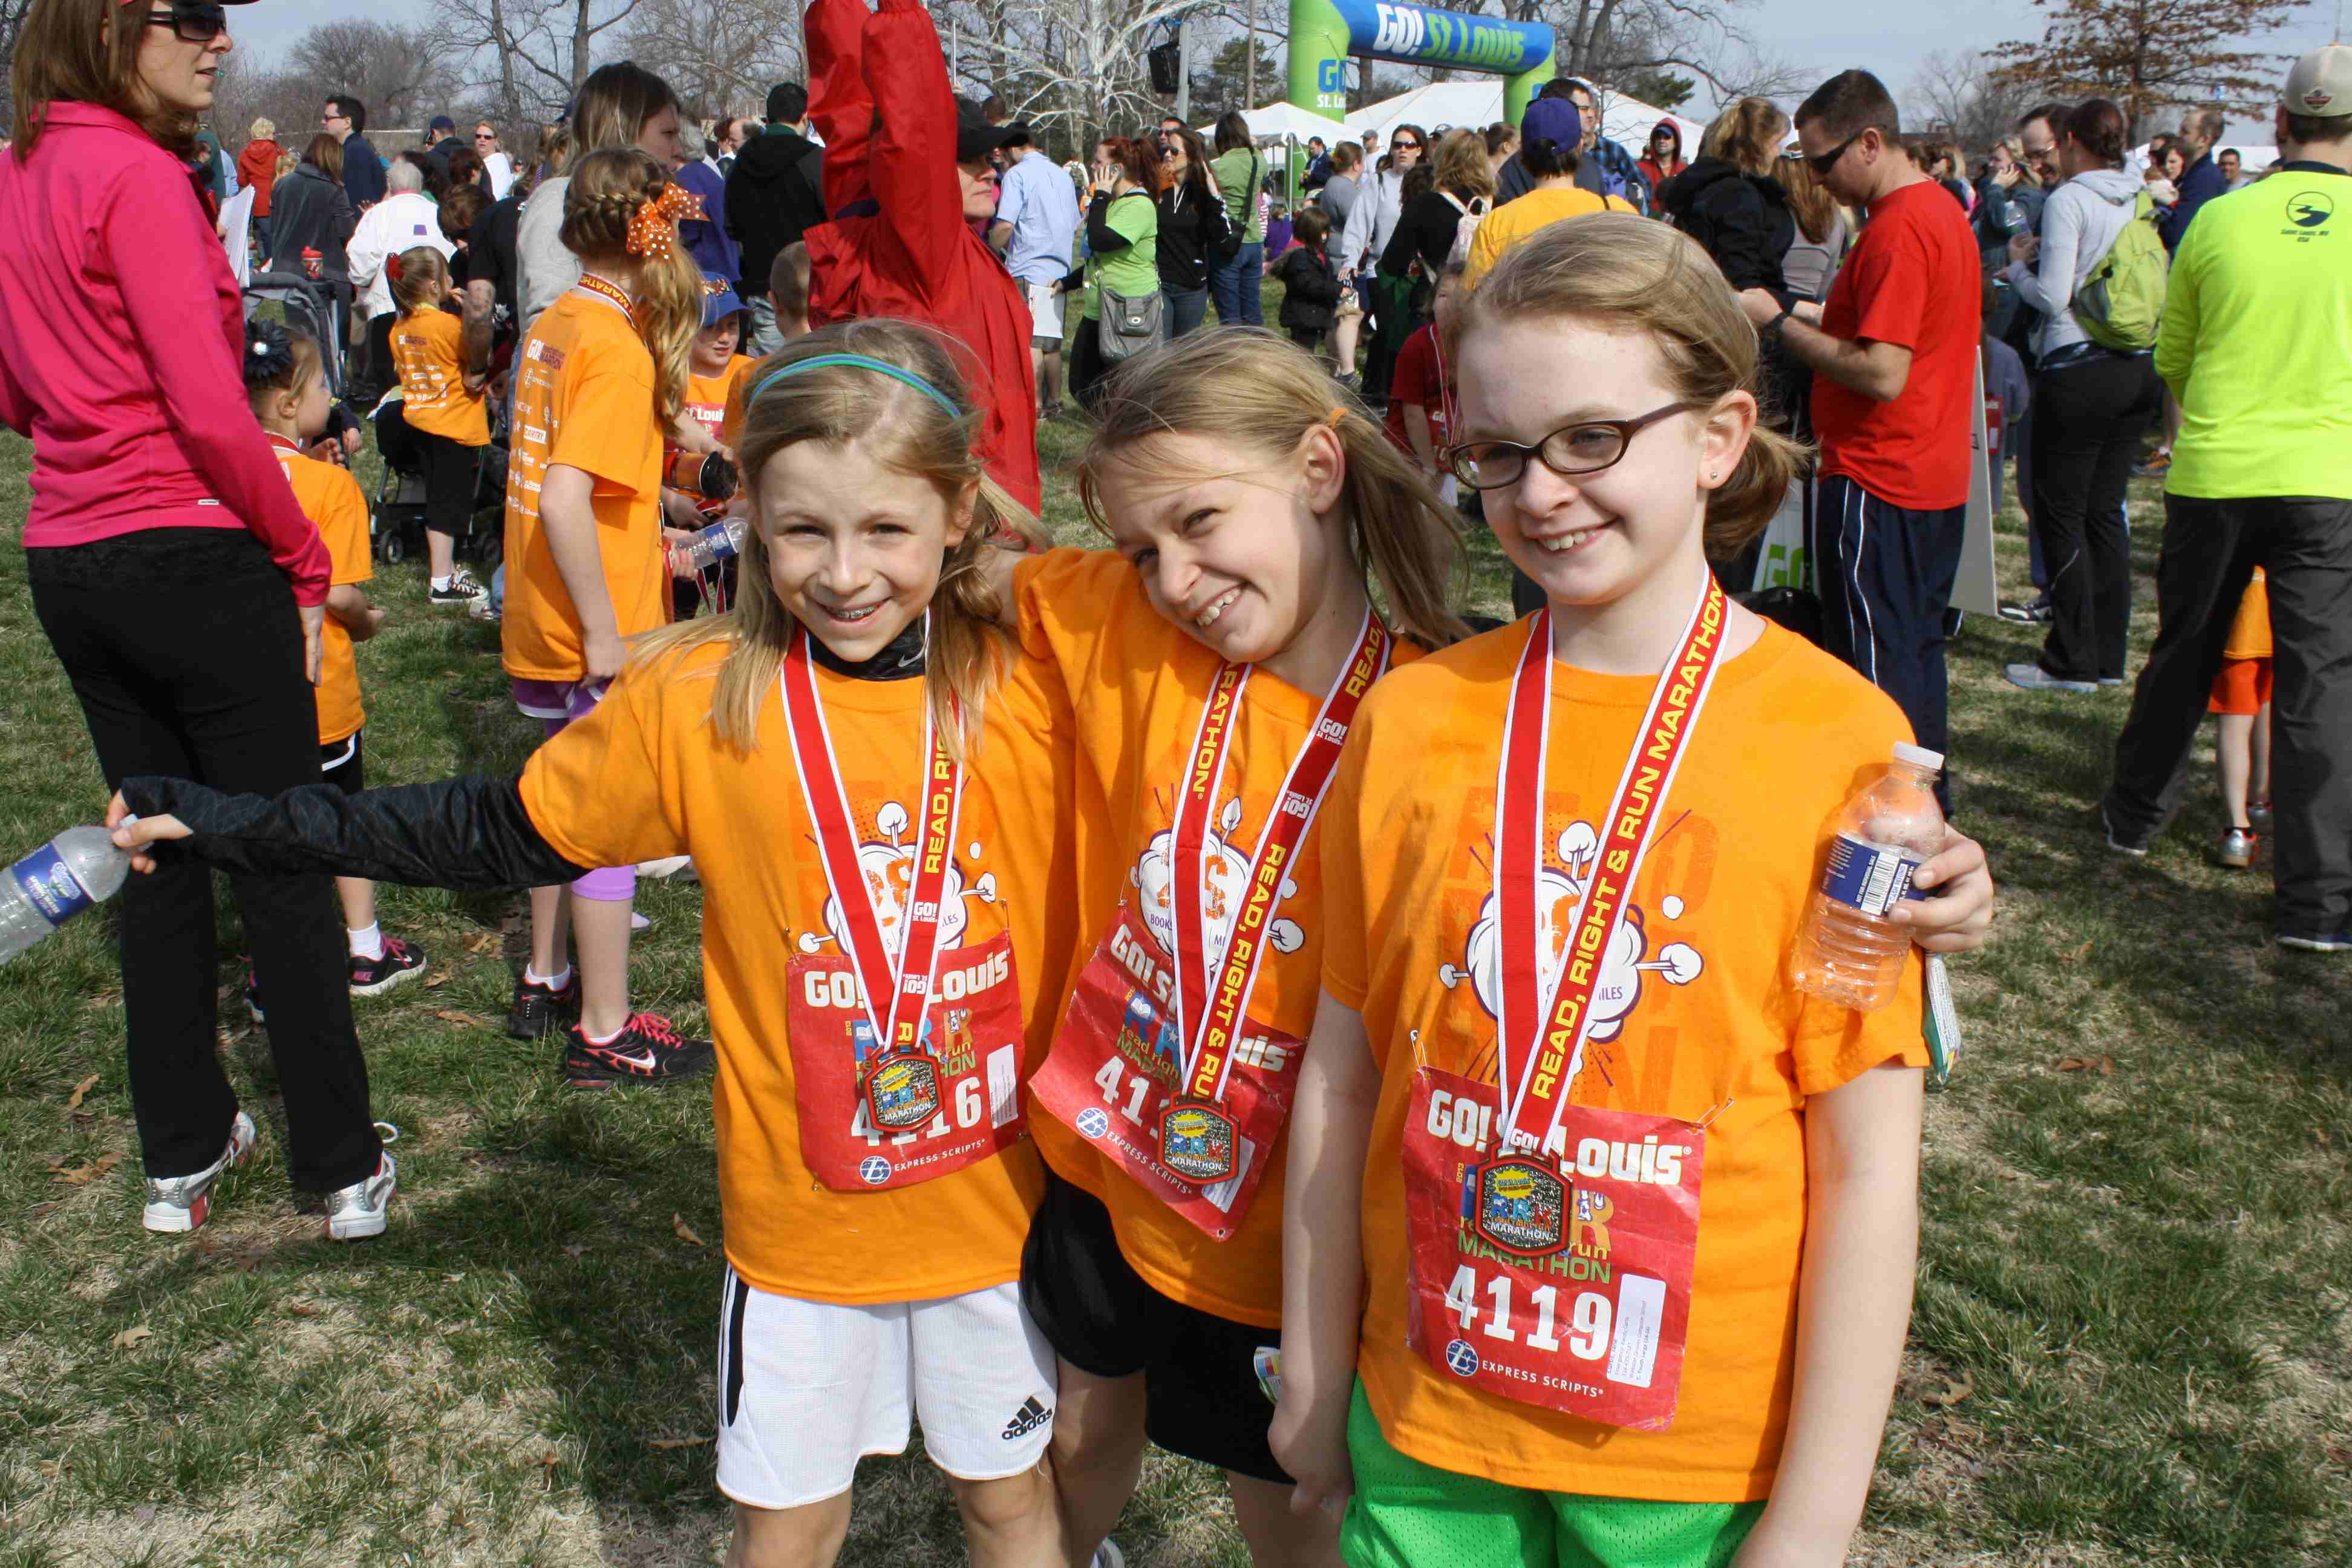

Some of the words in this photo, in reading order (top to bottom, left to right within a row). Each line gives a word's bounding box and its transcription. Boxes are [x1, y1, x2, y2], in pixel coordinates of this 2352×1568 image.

[1373, 4, 1423, 55] GO!
[1422, 12, 1452, 57] St.
[1455, 18, 1527, 68] Louis
[1345, 629, 1383, 698] READ,
[1647, 578, 1726, 761] MARATHON
[1320, 717, 1347, 739] GO!
[1282, 797, 1310, 819] GO!
[1616, 766, 1661, 840] RUN
[924, 786, 953, 874] READ,
[1606, 849, 1630, 874] &
[1238, 842, 1287, 933] READ,
[913, 901, 938, 917] GO!
[942, 913, 958, 927] LES
[1569, 877, 1616, 987] RIGHT
[1110, 924, 1155, 984] GO!
[903, 979, 927, 995] GO!
[1217, 938, 1253, 1031] RIGHT
[1122, 1024, 1151, 1054] read
[1208, 1028, 1226, 1048] &
[1532, 994, 1587, 1100] READ,
[851, 1076, 982, 1147] 416
[884, 1102, 933, 1122] MARATHON
[1094, 1055, 1168, 1140] 41
[894, 1152, 939, 1172] EXPRESS
[942, 1140, 981, 1158] SCRIPTS
[1427, 1089, 1491, 1153] GO!
[1553, 1124, 1682, 1186] Louis
[1510, 1128, 1540, 1150] GO!
[1106, 1131, 1149, 1165] EXPRESS
[1149, 1162, 1187, 1194] SCRIPTS
[1172, 1156, 1223, 1172] MARATHON
[1491, 1222, 1549, 1240] MARATHON
[1569, 1240, 1609, 1260] run
[1445, 1264, 1612, 1361] 4119
[1482, 1359, 1538, 1384] EXPRESS
[1543, 1376, 1598, 1398] SCRIPTS
[1002, 1408, 1052, 1440] adidas
